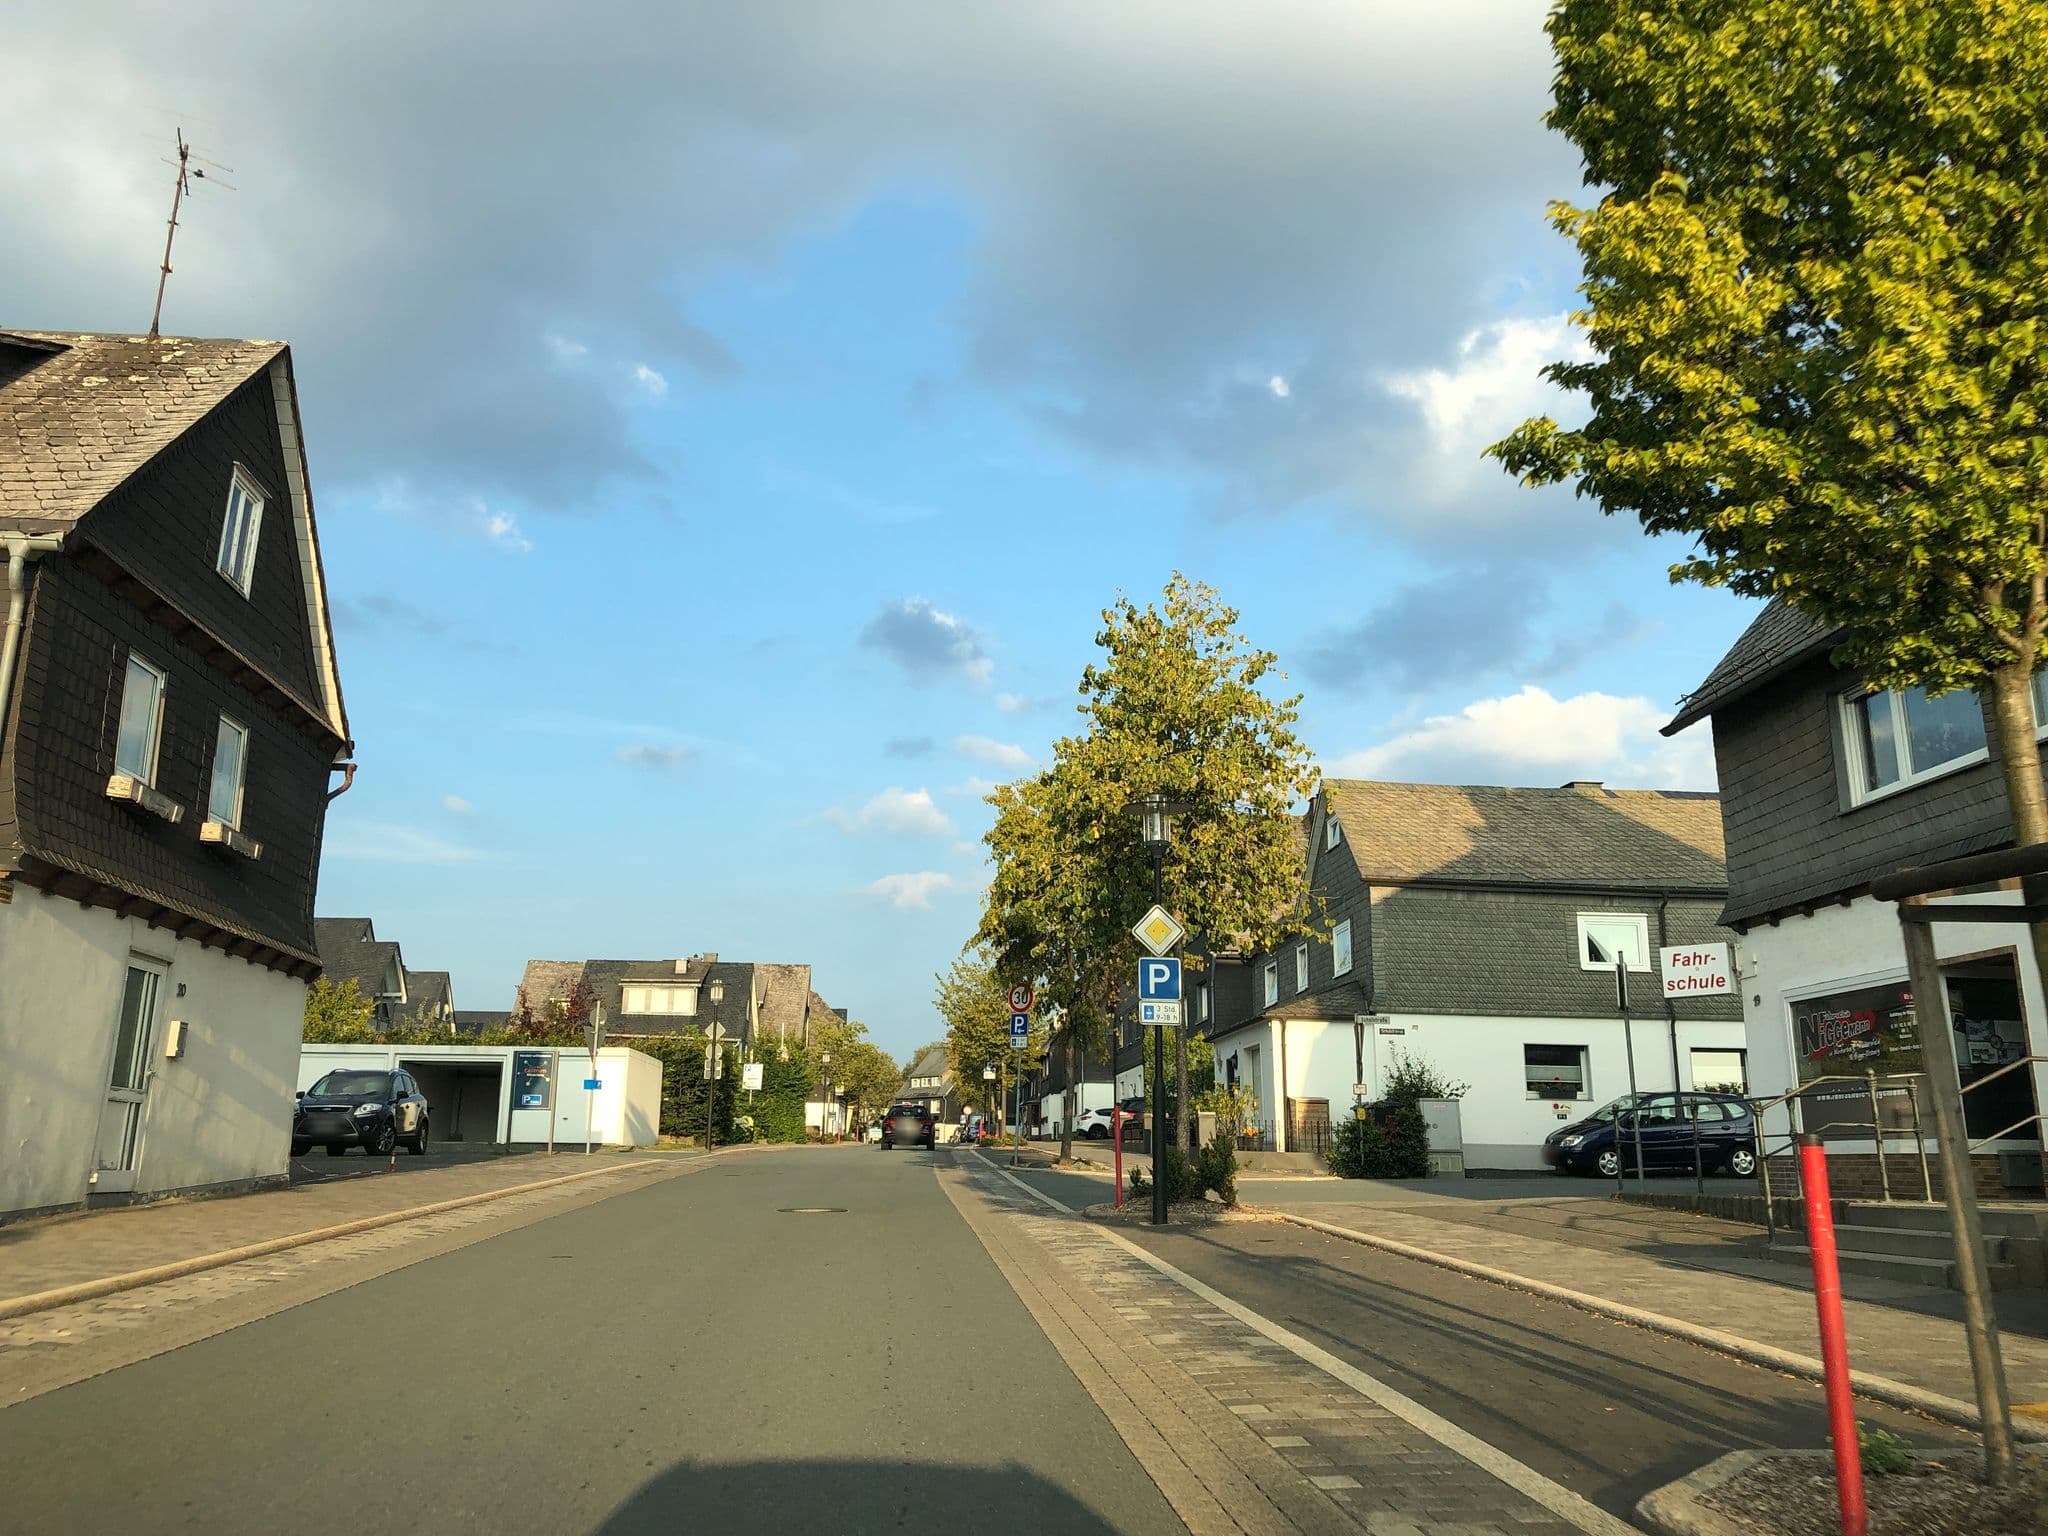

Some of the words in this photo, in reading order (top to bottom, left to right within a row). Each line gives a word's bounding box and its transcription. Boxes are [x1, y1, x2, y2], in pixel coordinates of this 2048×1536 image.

[1672, 952, 1716, 967] Fahr-
[1149, 963, 1170, 994] P
[1667, 974, 1726, 991] schule
[1014, 991, 1029, 1004] 30
[1015, 1016, 1024, 1033] P
[1173, 1014, 1178, 1022] h
